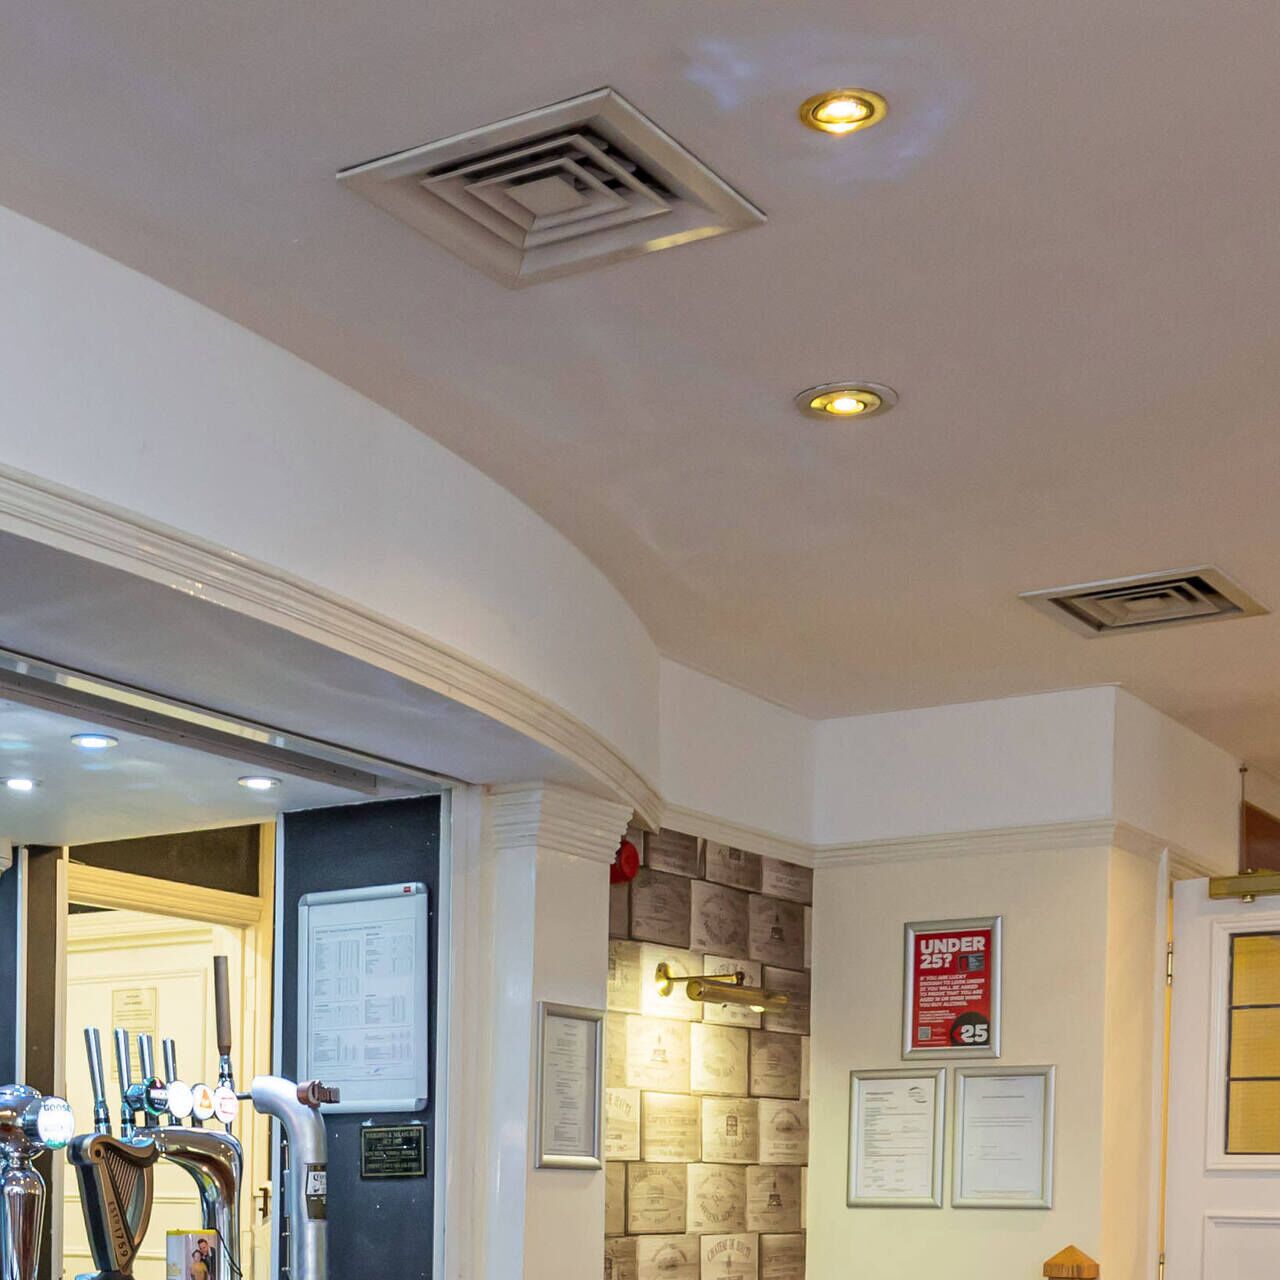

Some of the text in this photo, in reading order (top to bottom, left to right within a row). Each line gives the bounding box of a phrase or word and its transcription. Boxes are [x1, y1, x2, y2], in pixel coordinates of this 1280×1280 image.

[920, 936, 986, 953] UNDER
[920, 953, 953, 969] 25?
[961, 1024, 988, 1043] 25
[114, 1226, 129, 1258] 1759
